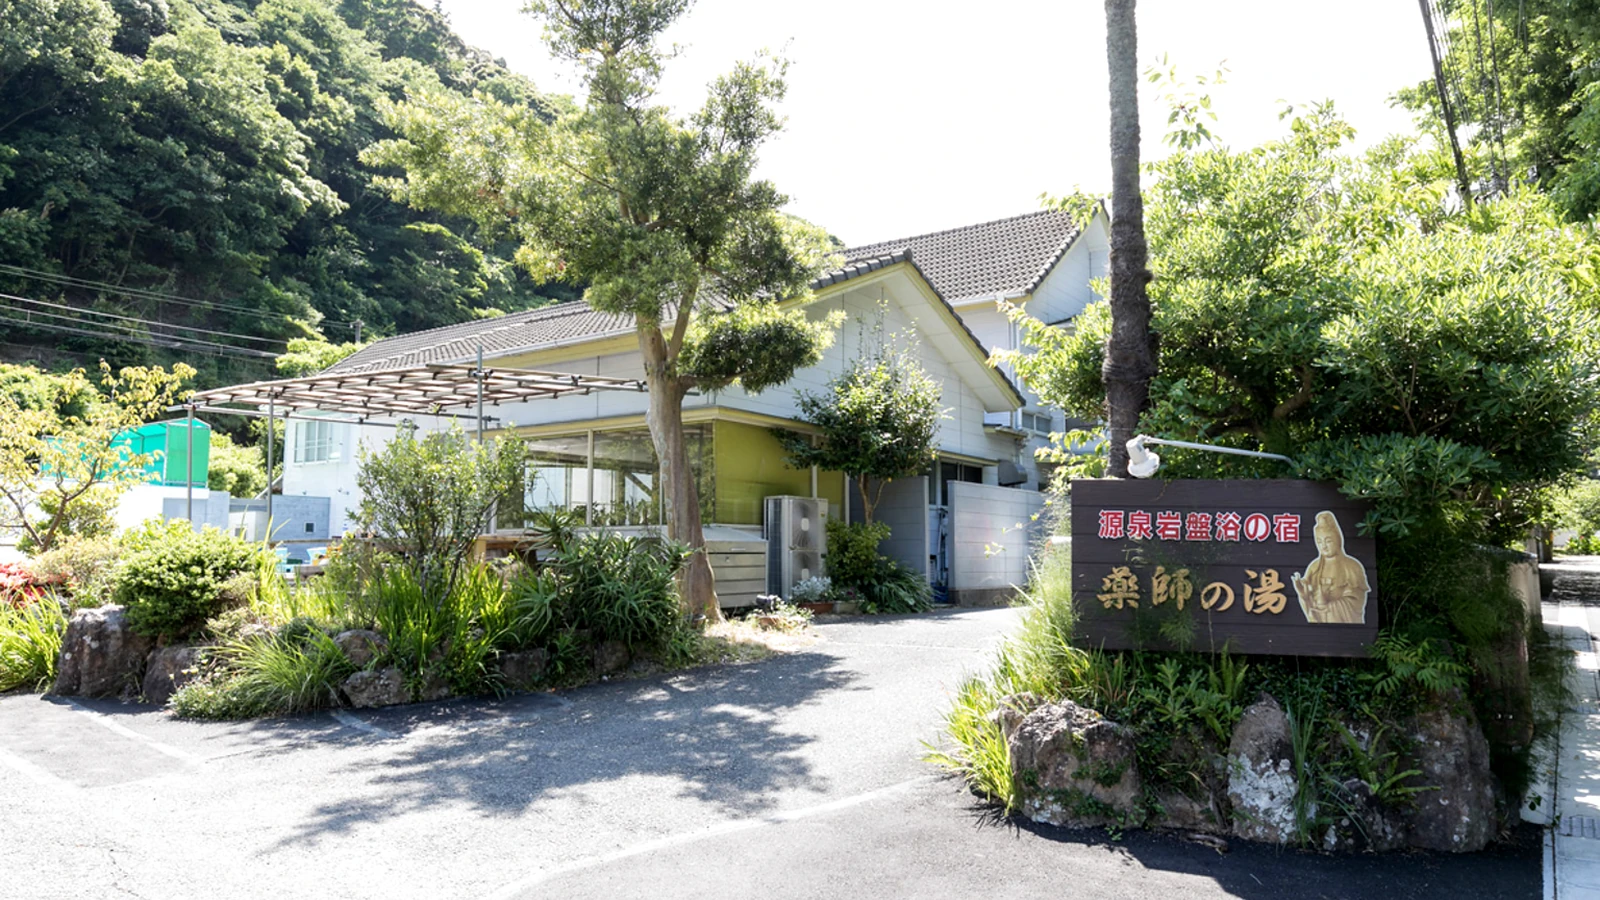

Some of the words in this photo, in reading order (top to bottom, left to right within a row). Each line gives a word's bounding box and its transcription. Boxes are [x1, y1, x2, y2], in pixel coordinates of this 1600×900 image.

[1098, 509, 1300, 542] 源泉岩盤浴の宿
[1097, 566, 1287, 614] 薬師の湯
